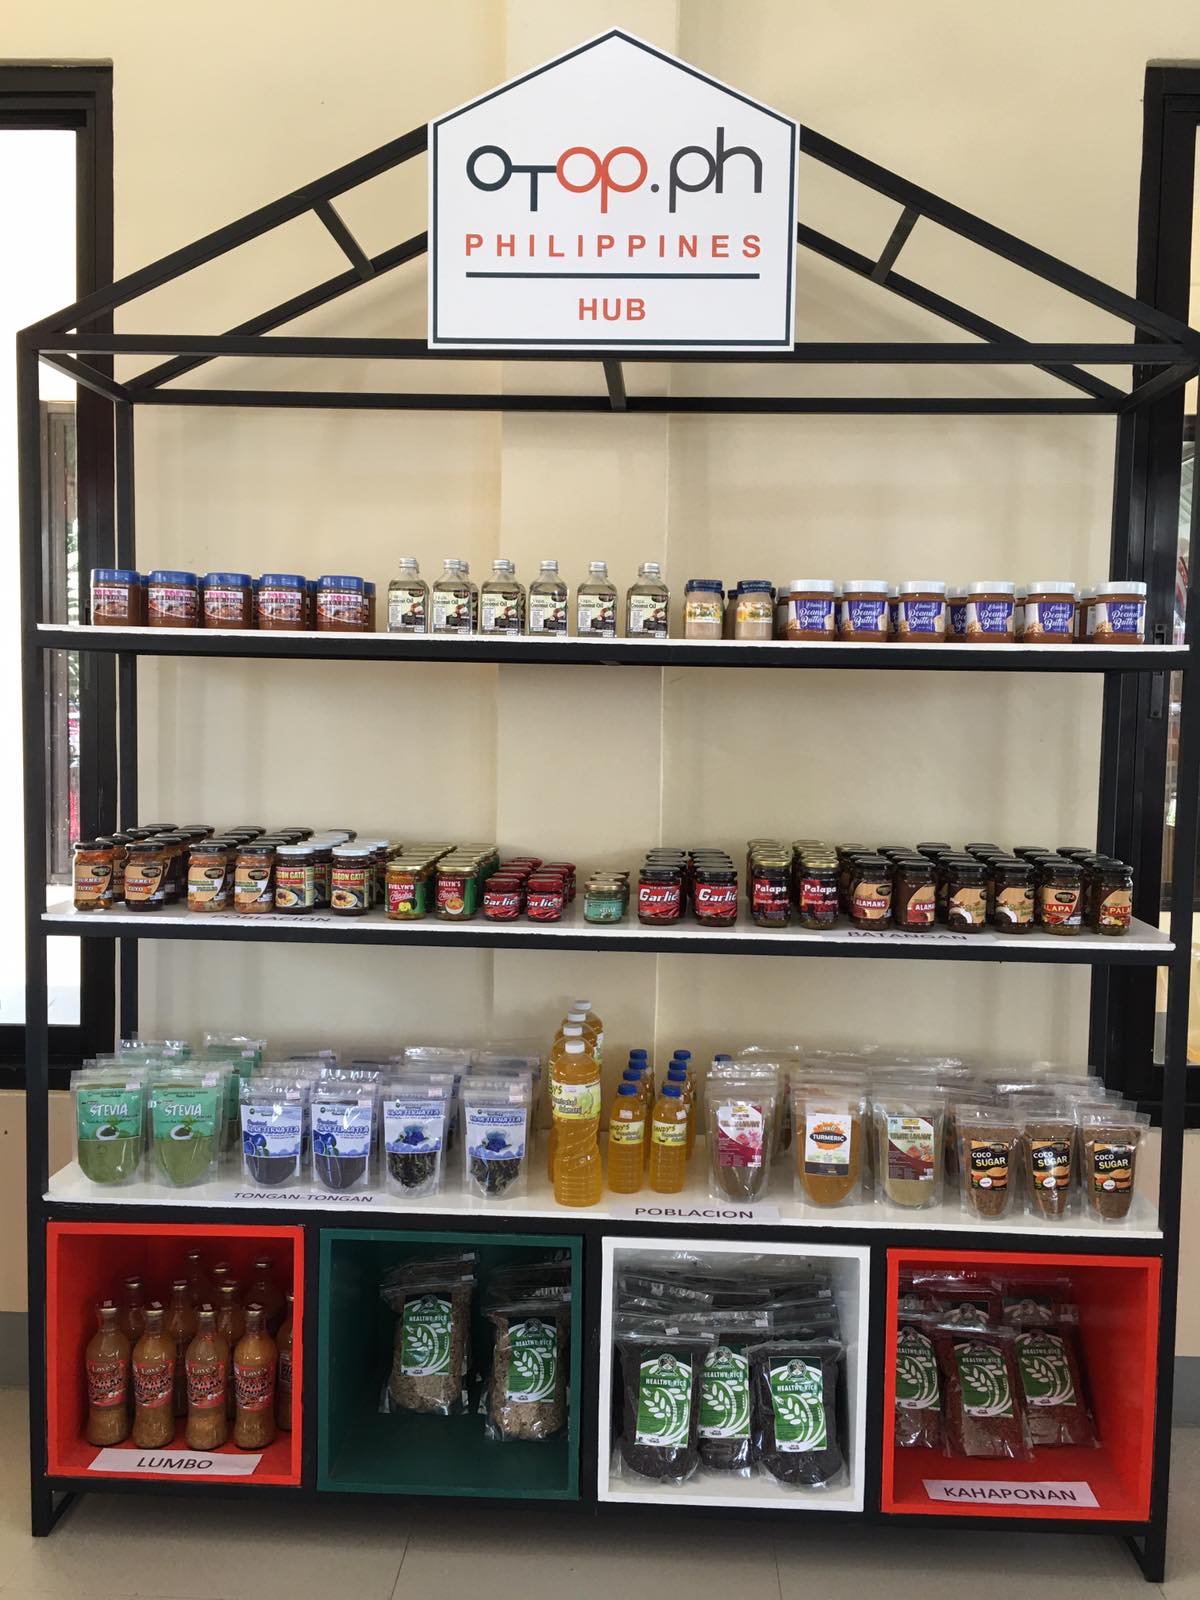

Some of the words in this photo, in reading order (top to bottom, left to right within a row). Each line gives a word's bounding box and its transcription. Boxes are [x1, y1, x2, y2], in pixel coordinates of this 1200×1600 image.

[465, 233, 761, 258] PHILIPPINES
[579, 298, 646, 321] HUB
[755, 884, 787, 894] Palapa
[804, 884, 837, 894] Palapa
[640, 888, 679, 902] Garlic
[484, 895, 516, 906] Garlic
[527, 896, 554, 906] arlic
[90, 1103, 128, 1116] STEVIA
[165, 1103, 202, 1116] STEVIA
[813, 1134, 845, 1142] TURMERIC
[1033, 1151, 1053, 1159] COCO
[976, 1157, 1006, 1167] SUGAR
[1038, 1156, 1067, 1167] SUGAR
[1099, 1160, 1128, 1170] SUGAR
[234, 1192, 373, 1202] TONGAN-TONGAN
[635, 1208, 753, 1218] POBLACION
[646, 1378, 671, 1386] HEALTHY
[136, 1456, 214, 1469] LUMBO
[943, 1486, 1078, 1501] KAHAPONAN
